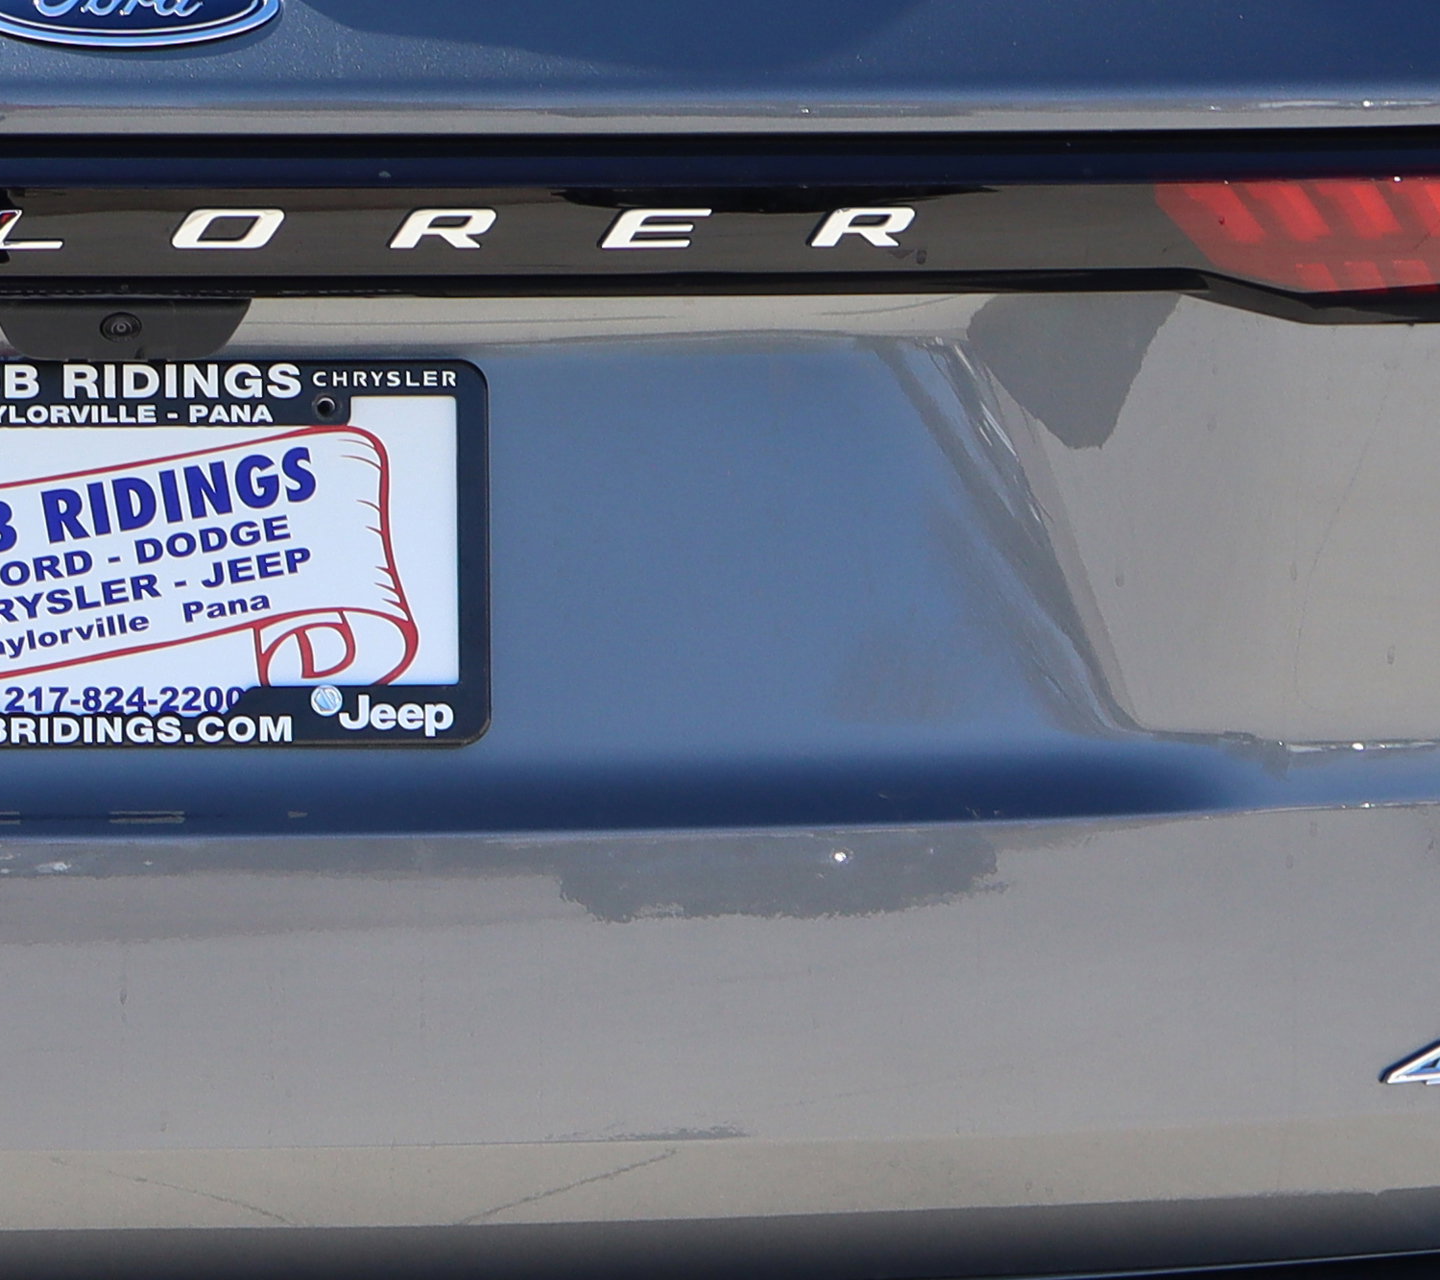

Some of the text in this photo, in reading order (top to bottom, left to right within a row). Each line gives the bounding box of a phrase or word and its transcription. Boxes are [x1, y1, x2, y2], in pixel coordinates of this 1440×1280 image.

[63, 363, 303, 399] RIDINGS
[312, 371, 457, 388] CHRYSLER
[189, 404, 274, 423] PANA
[40, 446, 317, 545] RIDINGS
[134, 515, 291, 565] DODGE
[201, 547, 312, 589] JEEP
[182, 594, 271, 623] Pana
[4, 685, 242, 714] 217-824-2200
[339, 694, 454, 737] Jeep
